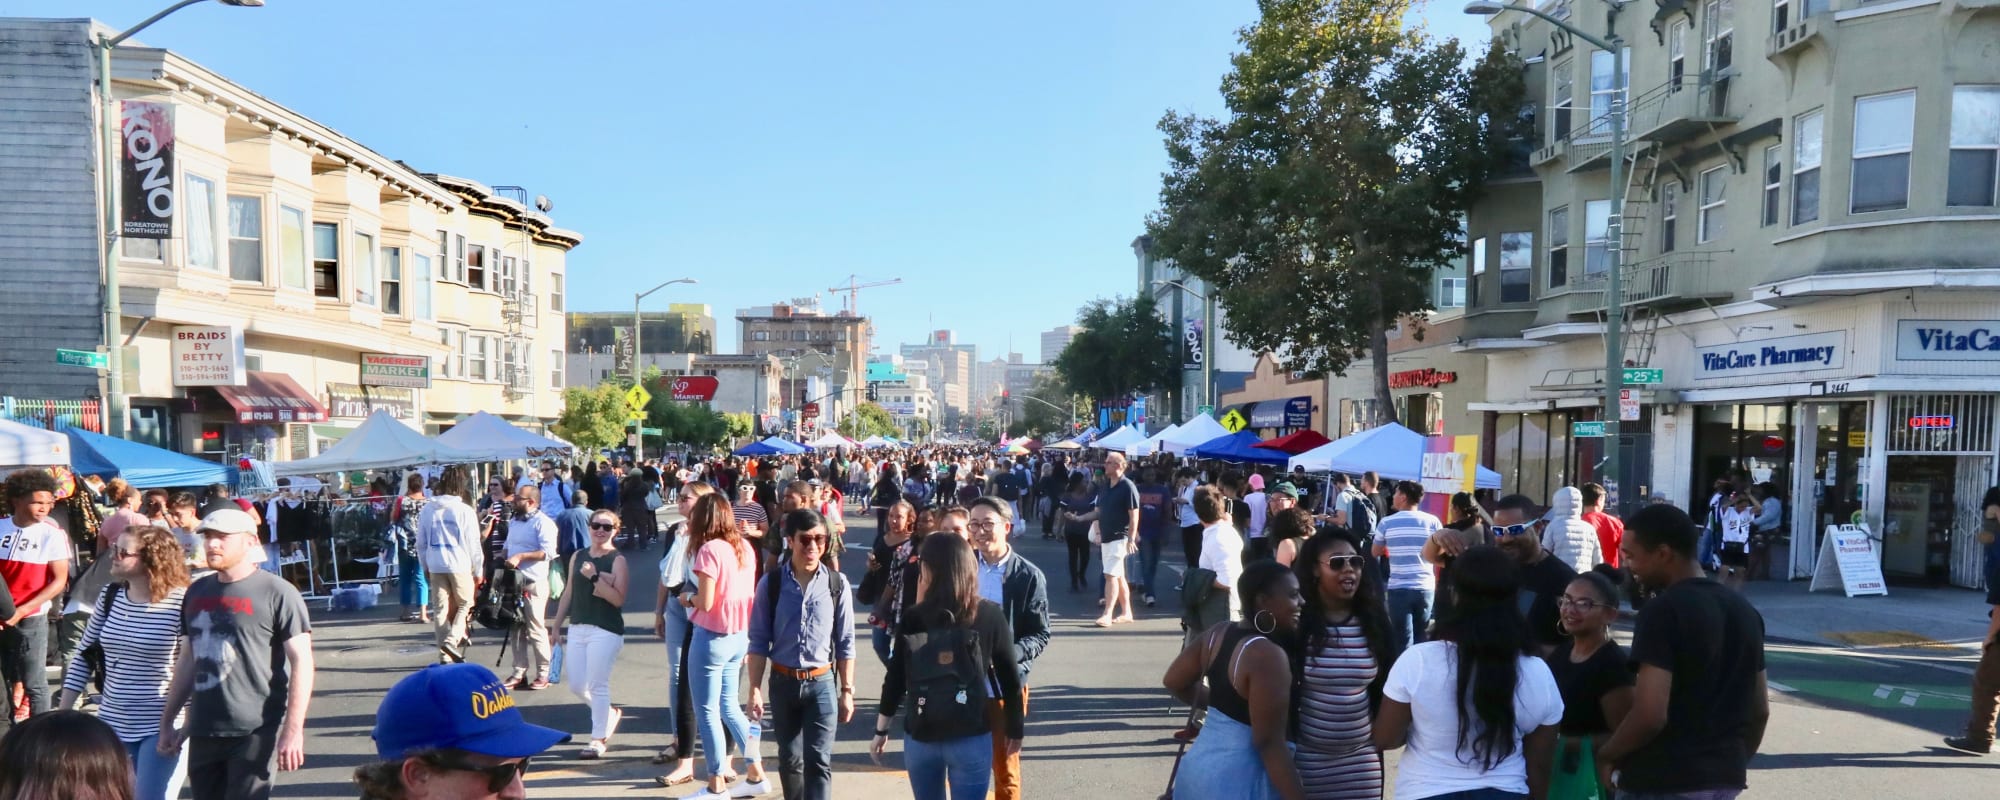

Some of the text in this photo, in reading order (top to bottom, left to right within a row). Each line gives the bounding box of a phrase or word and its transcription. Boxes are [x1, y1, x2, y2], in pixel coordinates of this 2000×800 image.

[121, 105, 173, 218] KONO
[124, 227, 169, 235] NORTHGATE
[178, 332, 226, 340] BRAIDS
[1185, 321, 1202, 362] KONO
[1916, 328, 2000, 351] VitaCa
[60, 352, 93, 366] Telegraph
[182, 353, 223, 361] BETTY
[366, 356, 424, 366] YAGERBET
[1702, 346, 1835, 371] VitaCare Pharmacy
[366, 365, 424, 377] MARKET
[1831, 382, 1850, 393] 2447
[1909, 417, 1951, 428] OPEN
[1421, 452, 1467, 478] BLACK
